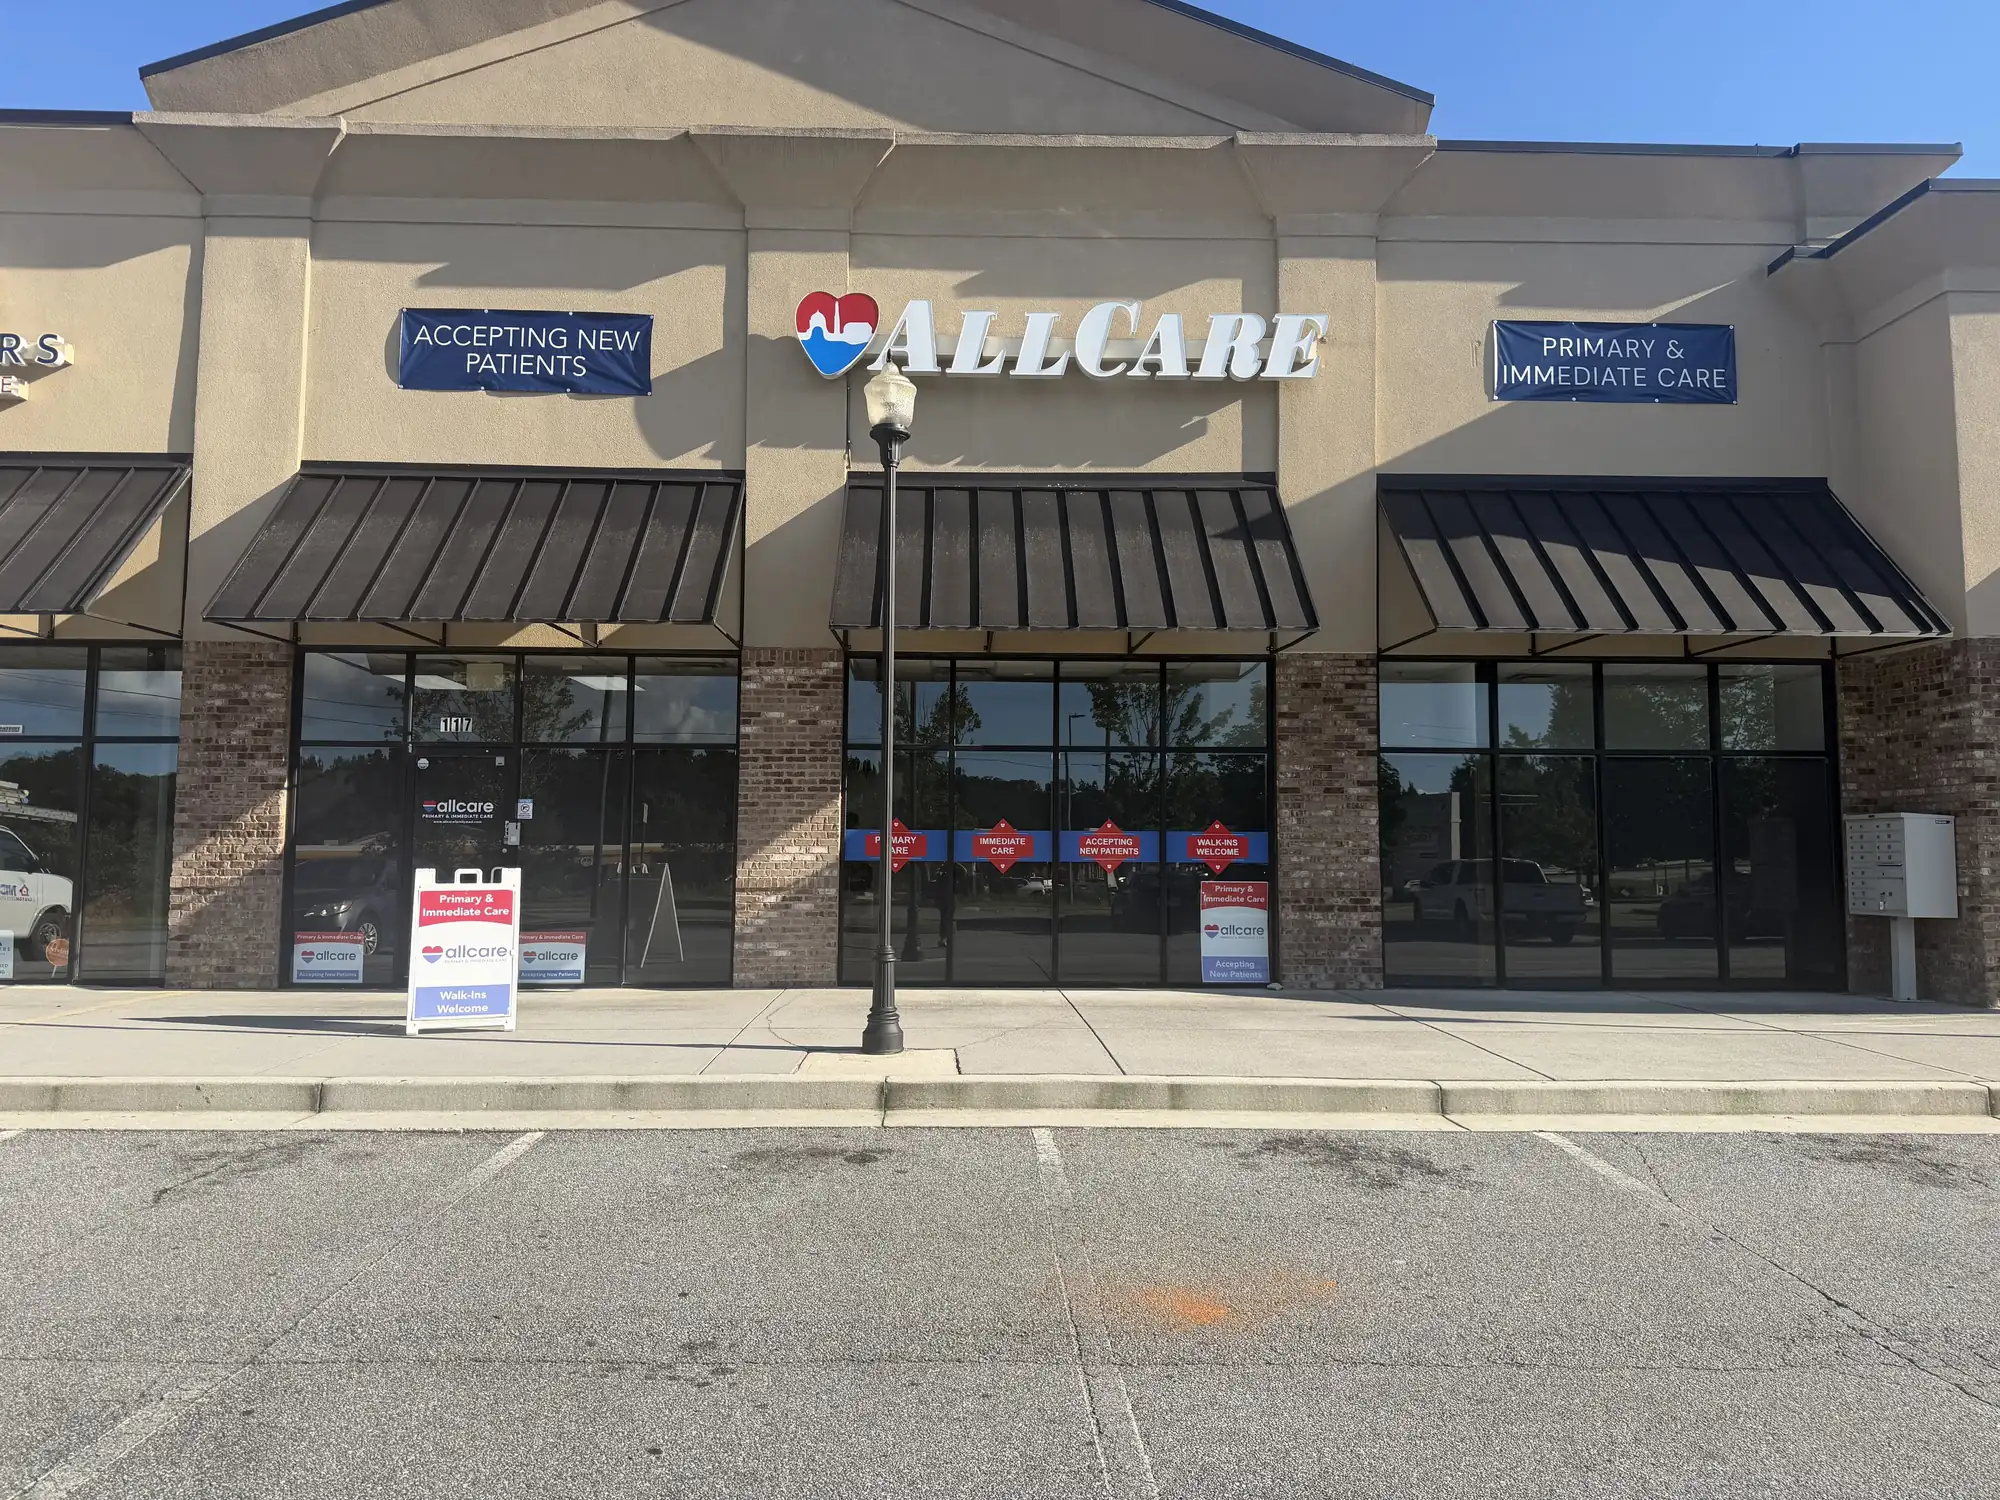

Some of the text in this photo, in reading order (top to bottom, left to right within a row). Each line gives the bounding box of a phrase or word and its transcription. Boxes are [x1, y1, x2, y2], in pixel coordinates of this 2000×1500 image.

[414, 325, 641, 351] ACCEPTING NEW
[1543, 337, 1684, 359] PRIMARY &
[466, 353, 587, 377] PATIENTS
[1502, 365, 1727, 388] IMMEDIATE CARE
[441, 718, 472, 732] 117
[437, 799, 494, 813] allcare
[875, 836, 917, 844] PMARY
[1085, 838, 1133, 846] ACCEPTING
[991, 847, 1015, 855] CARE
[1196, 848, 1239, 856] WELCOME
[1215, 885, 1245, 894] Primary
[439, 894, 494, 905] Primary &
[1203, 894, 1265, 903] Immediate Care
[422, 906, 509, 917] Immediate Care
[1220, 925, 1264, 935] allcare
[316, 950, 356, 961] allcare
[445, 945, 507, 958] allcare
[537, 950, 578, 961] allcare
[1215, 960, 1255, 969] Accepting
[1209, 970, 1262, 978] New Patients
[439, 990, 487, 1000] Walk-Ins
[436, 1004, 489, 1014] Welcome
